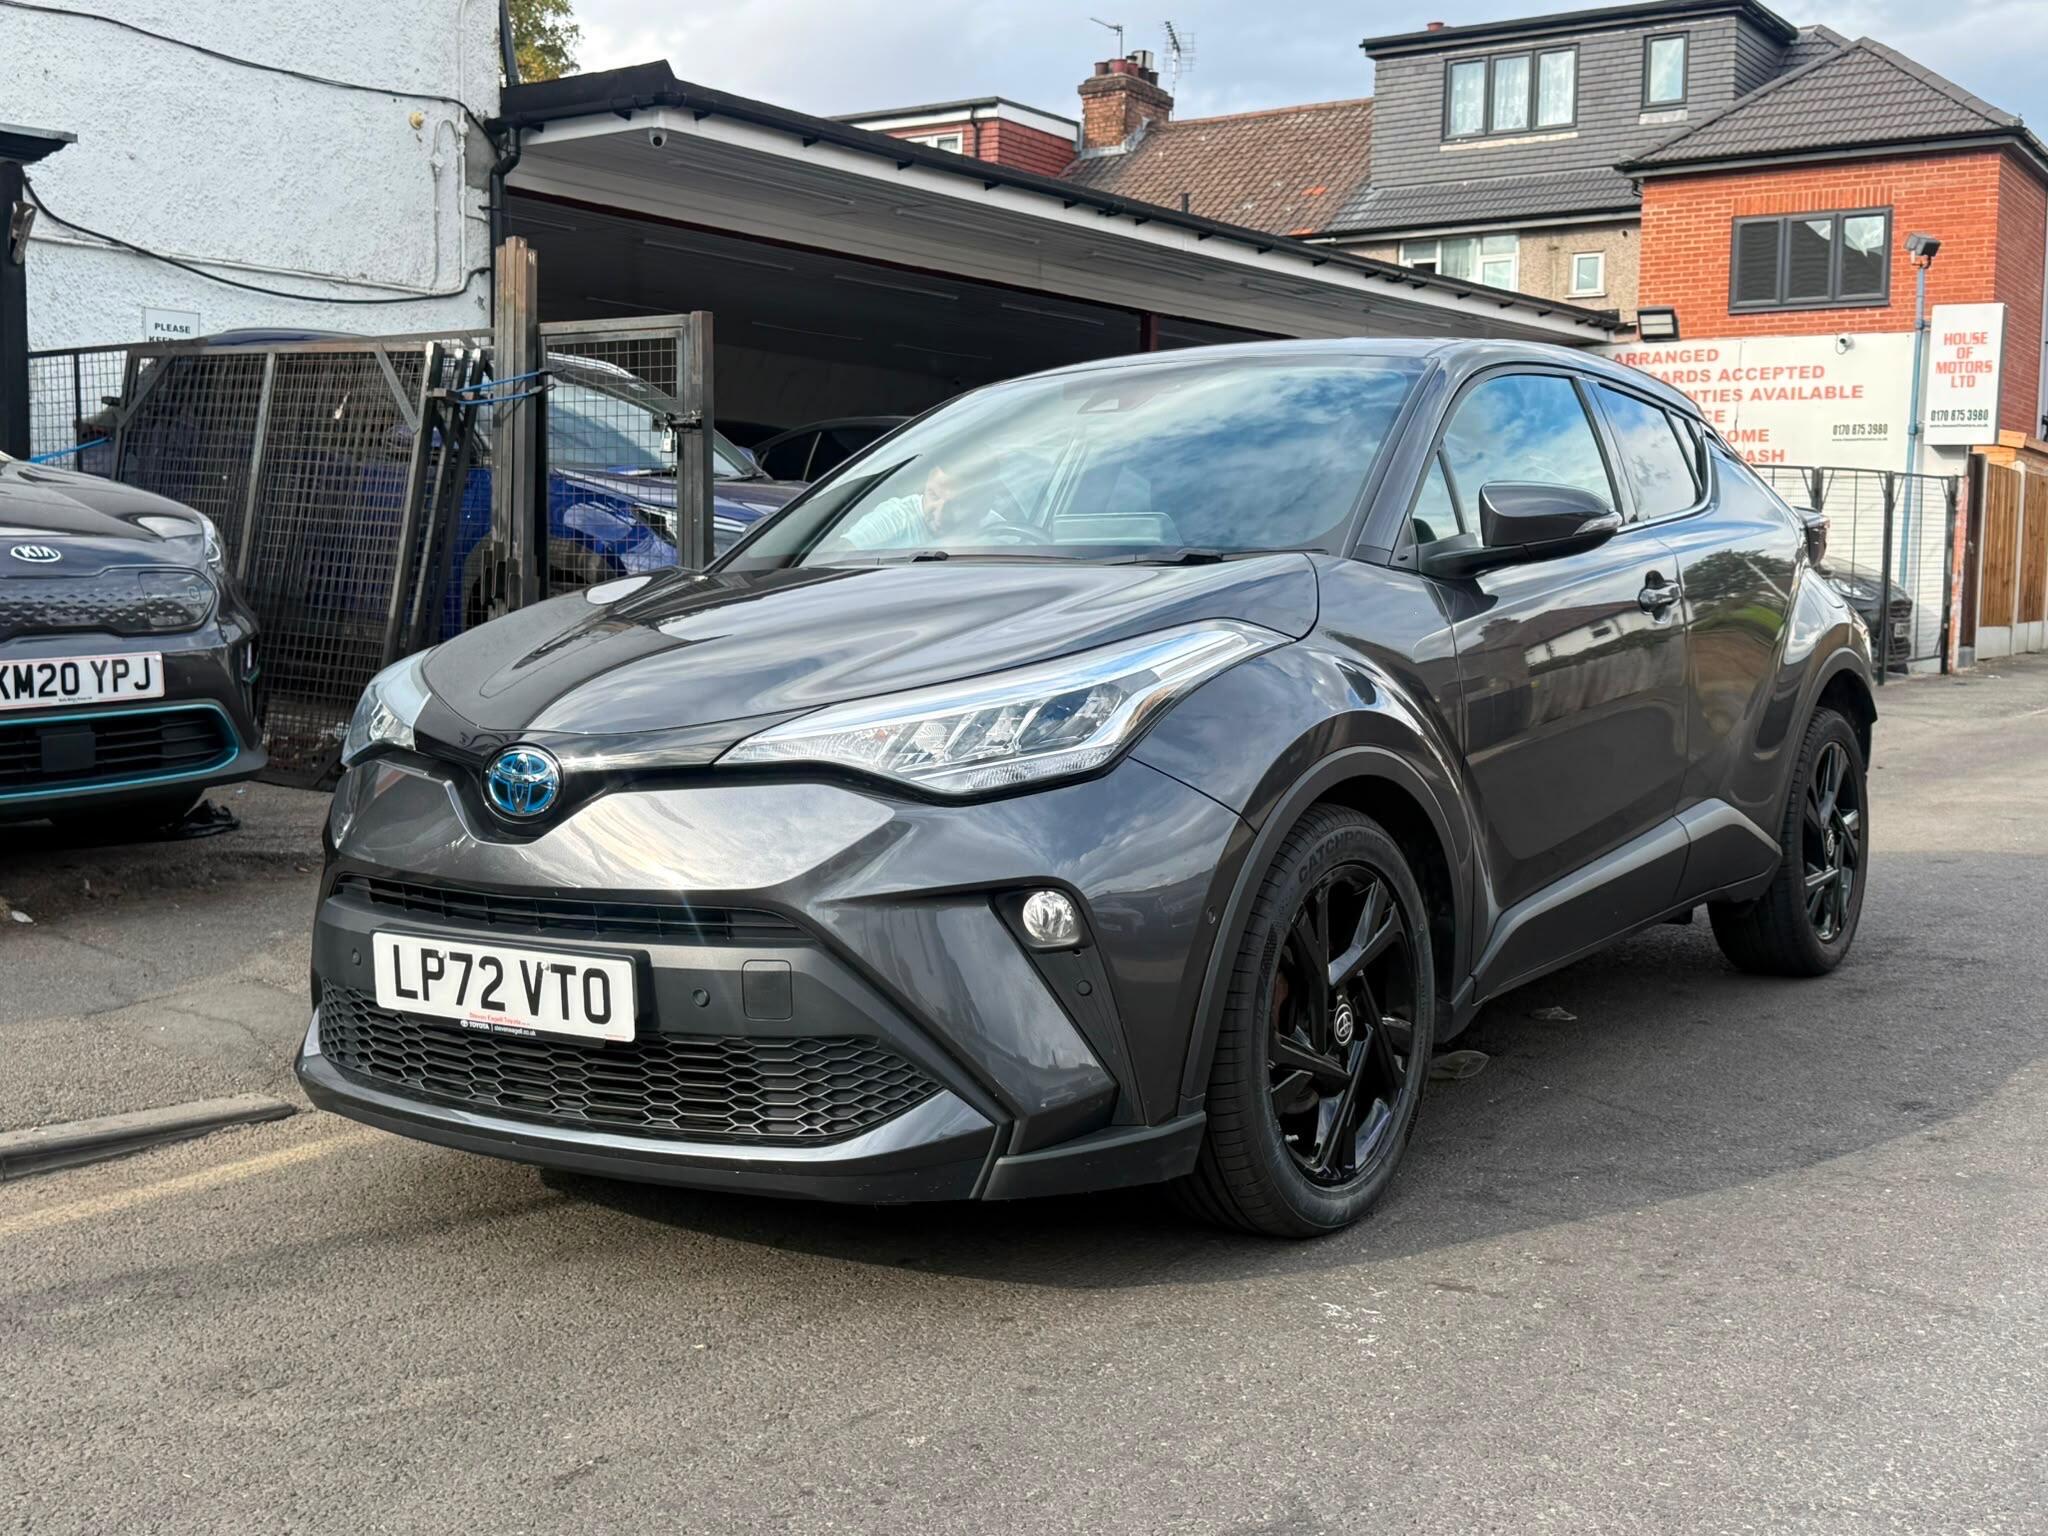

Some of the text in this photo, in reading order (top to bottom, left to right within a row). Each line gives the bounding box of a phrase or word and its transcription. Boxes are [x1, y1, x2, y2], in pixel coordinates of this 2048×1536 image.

[154, 322, 191, 334] PLEASE
[1943, 331, 1989, 346] HOUSE
[1614, 348, 1720, 365] ARRANGED
[1956, 346, 1974, 360] OF
[1935, 360, 1993, 374] MOTORS
[1651, 365, 1826, 384] ARDS ACCEPTED
[1951, 375, 1976, 388] LTD
[1749, 385, 1864, 401] AVAILABLE
[1930, 409, 1949, 421] 0170
[1967, 408, 1989, 421] 3980
[1832, 424, 1850, 436] 0170
[15, 544, 58, 559] KIA
[90, 656, 151, 694] YPJ
[392, 943, 612, 1026] LP72 VTO
[469, 1021, 490, 1031] TOYOTA
